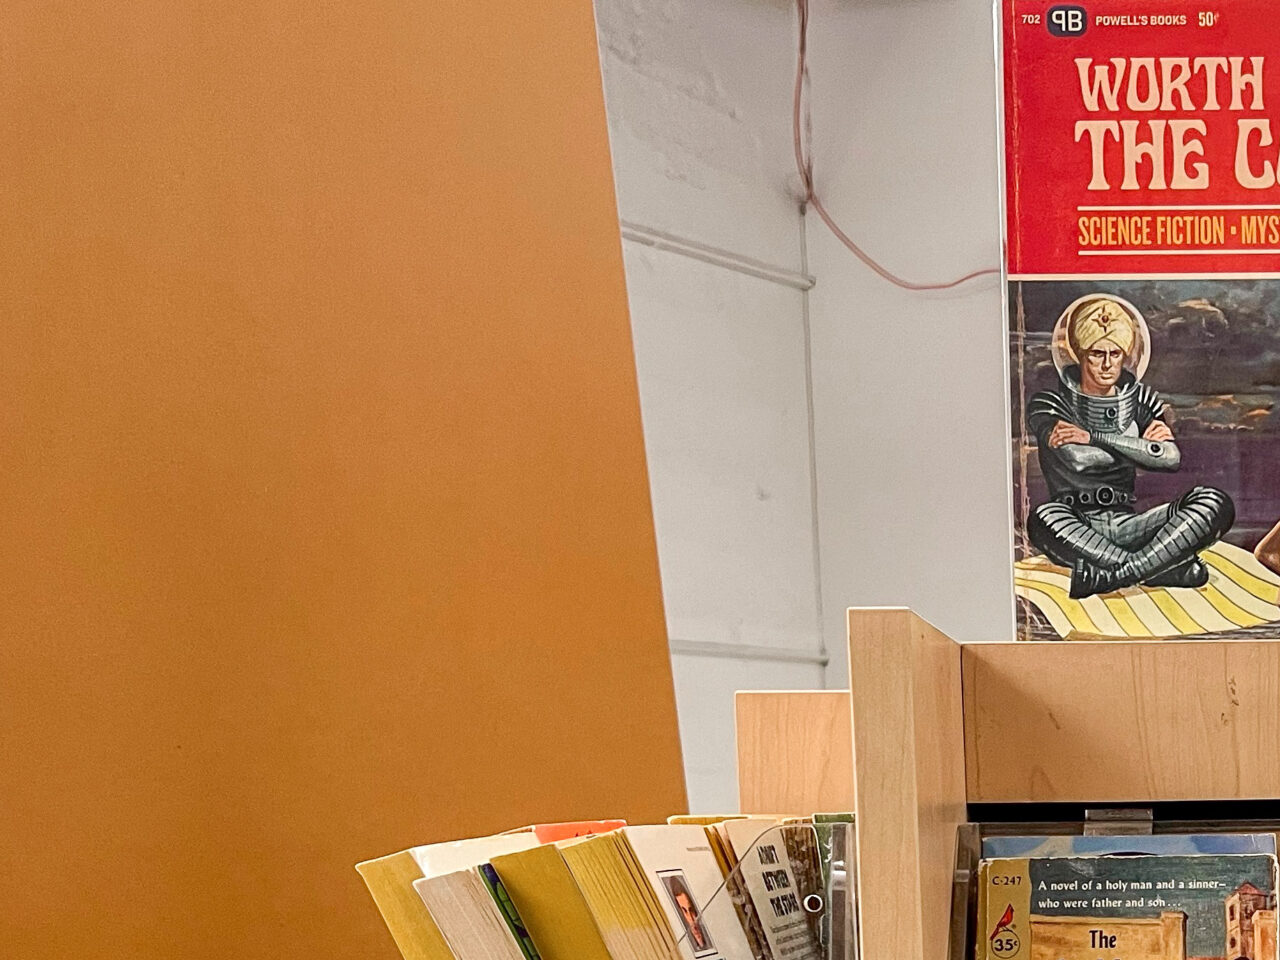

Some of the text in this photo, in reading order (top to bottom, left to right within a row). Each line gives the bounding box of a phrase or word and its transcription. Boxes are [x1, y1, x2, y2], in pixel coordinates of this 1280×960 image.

[1021, 14, 1041, 24] 702
[1095, 14, 1187, 26] POWELL'S BOOKS
[1073, 57, 1264, 112] WORTH
[1075, 119, 1209, 190] THE
[1078, 215, 1152, 246] SCIENCE
[1156, 214, 1225, 245] FICTION
[1038, 879, 1185, 892] A novel of a holy man and a
[1038, 897, 1144, 908] who were father and
[1089, 930, 1117, 949] The
